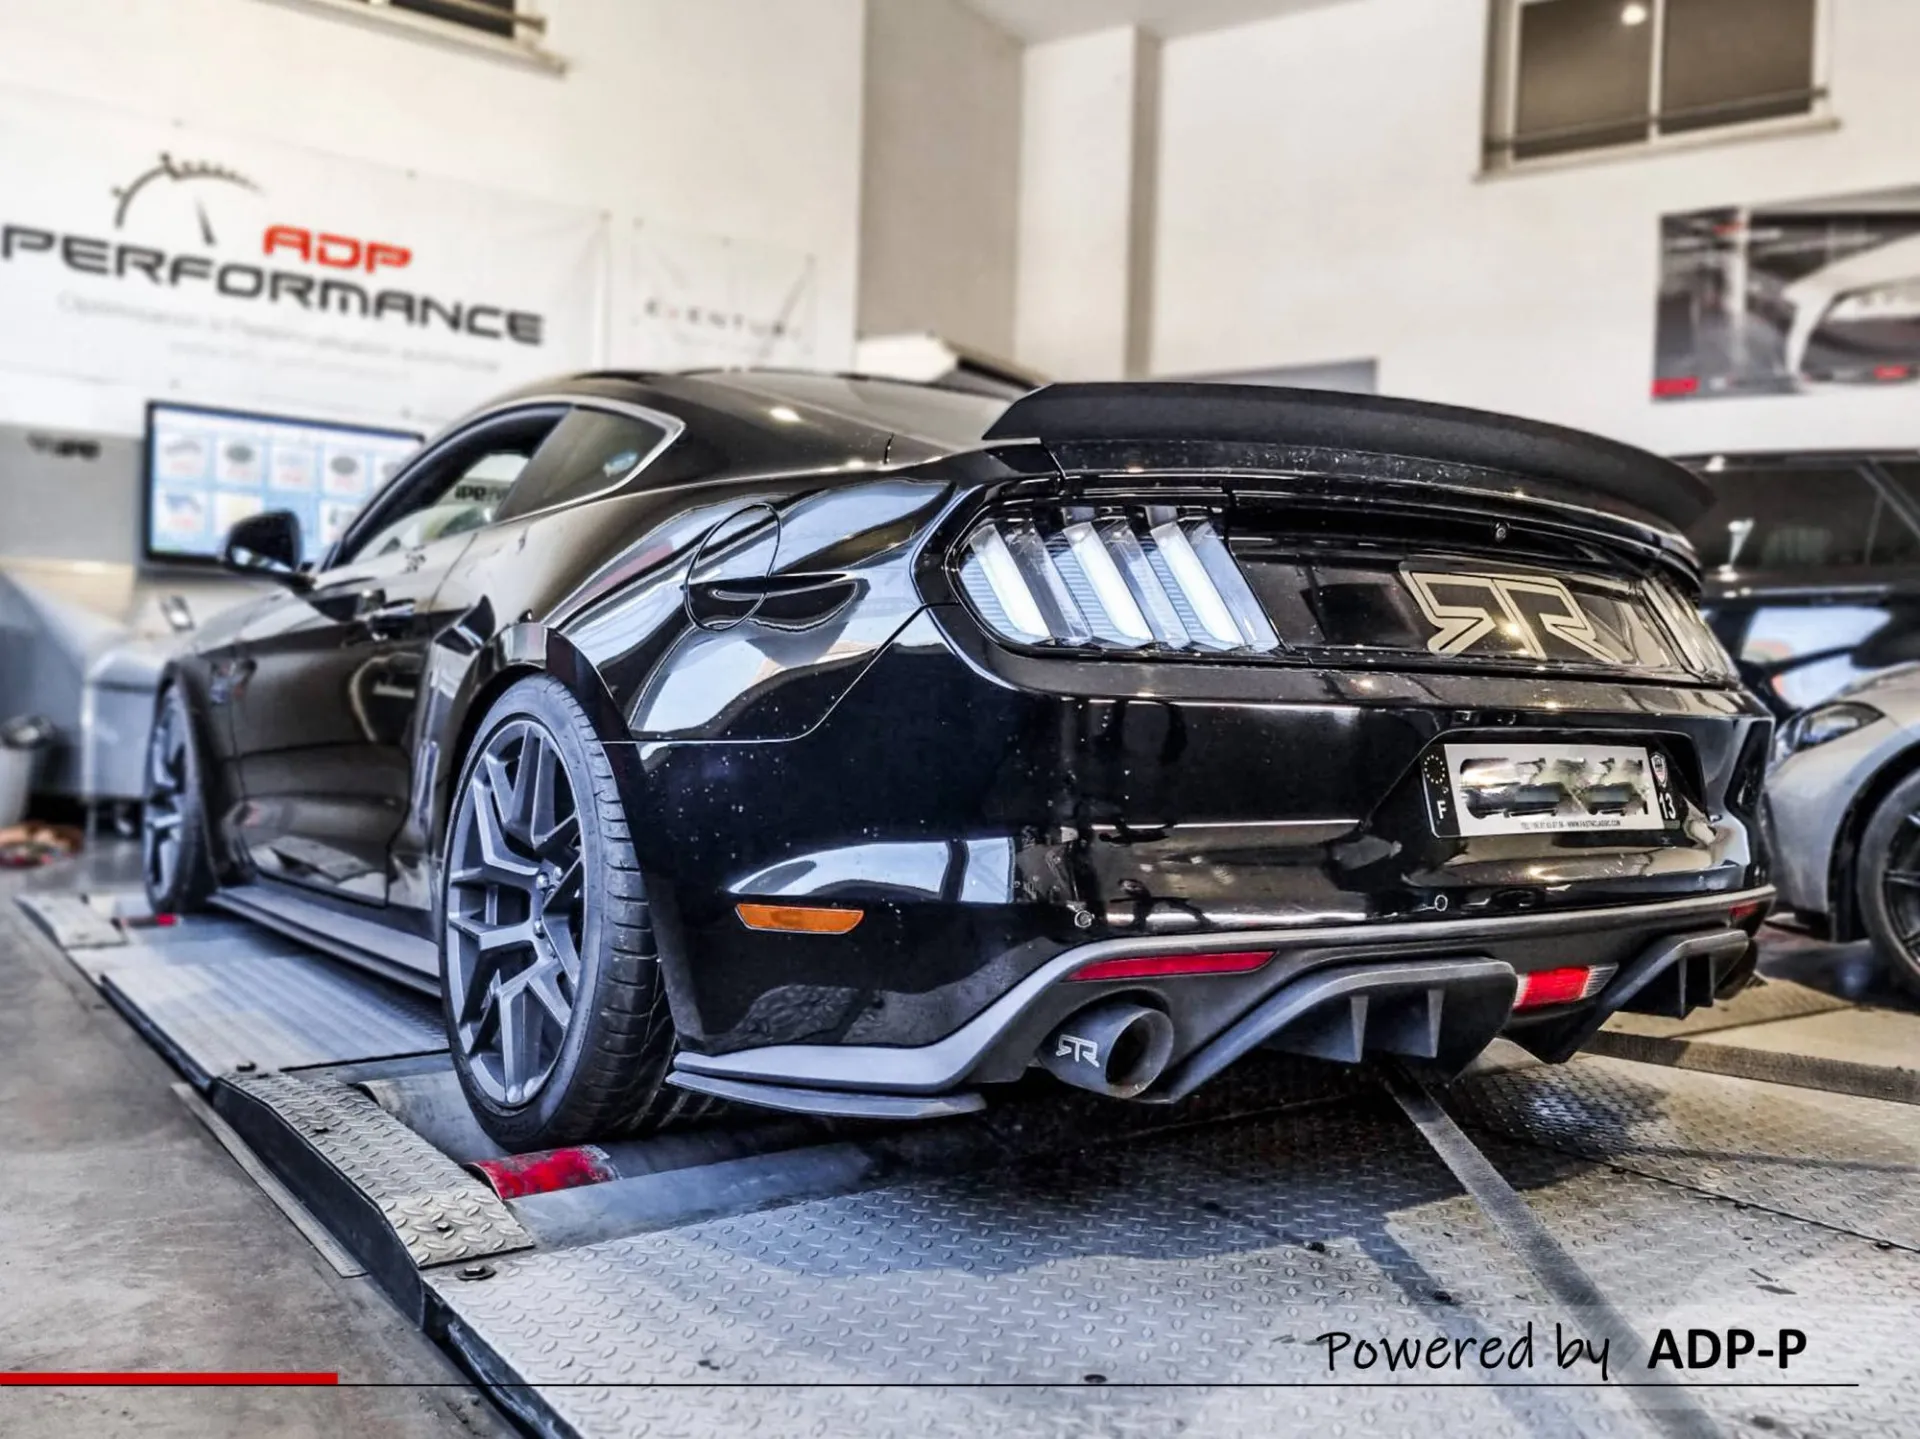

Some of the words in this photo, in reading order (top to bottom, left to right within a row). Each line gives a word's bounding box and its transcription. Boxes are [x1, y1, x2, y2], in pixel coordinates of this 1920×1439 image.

[262, 224, 413, 274] ADP
[1, 223, 547, 347] PERFORMANCE
[1436, 800, 1447, 819] F
[1659, 792, 1676, 819] 13
